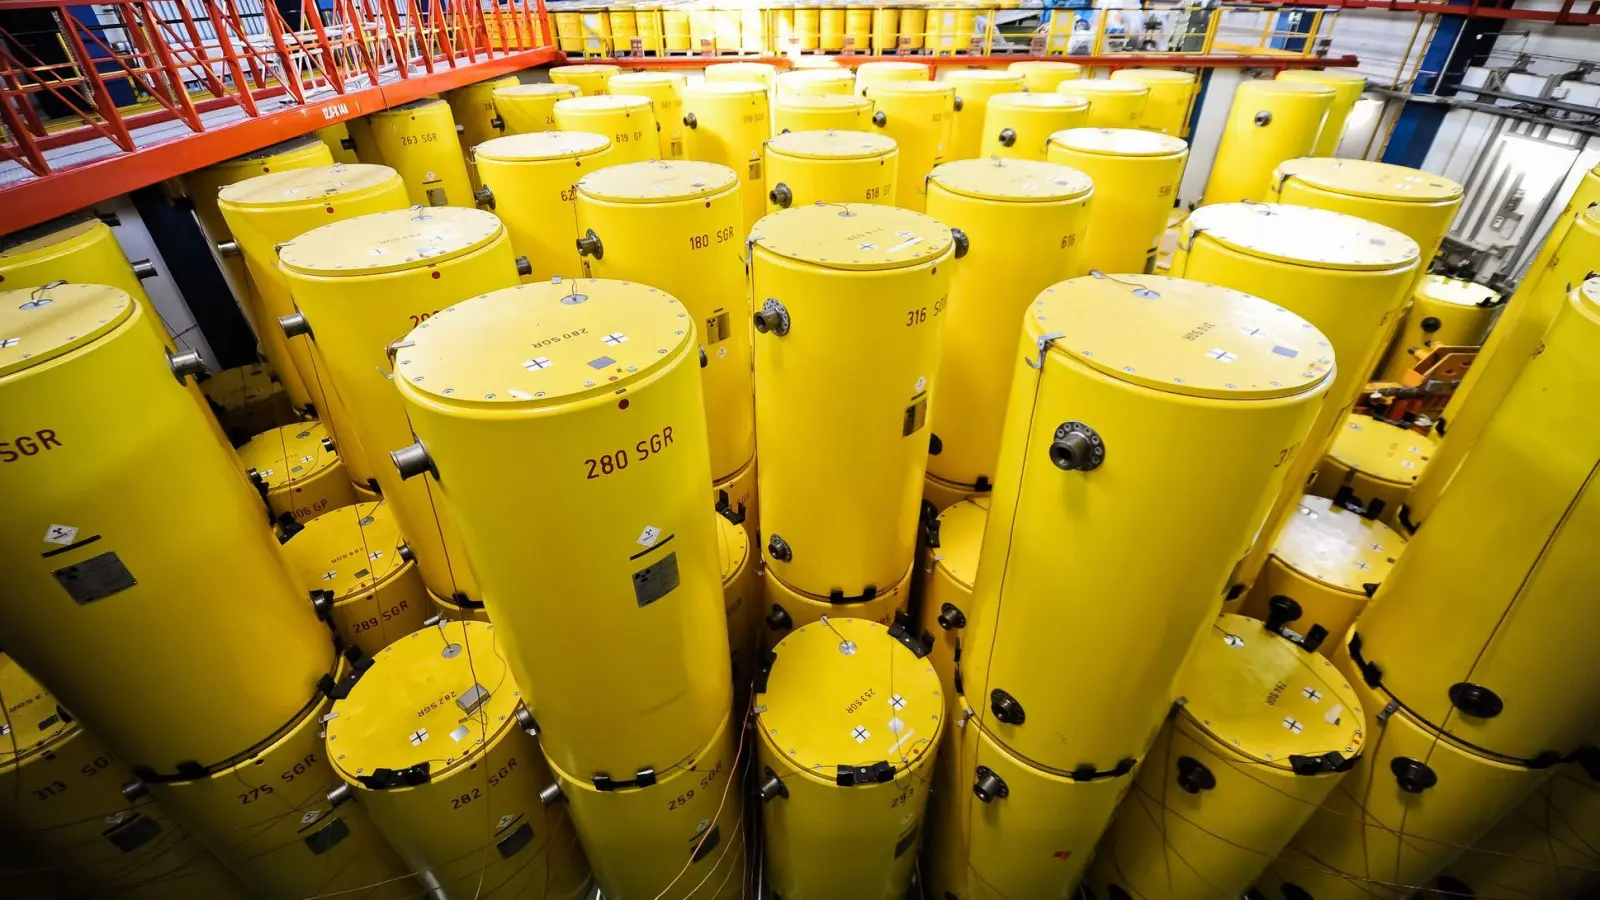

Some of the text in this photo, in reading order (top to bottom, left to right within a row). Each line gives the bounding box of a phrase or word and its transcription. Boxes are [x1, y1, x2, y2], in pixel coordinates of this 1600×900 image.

[401, 132, 438, 146] 263 SGR
[615, 131, 643, 143] 619 GP
[689, 225, 733, 250] 180 SGR
[906, 307, 927, 327] 316
[532, 328, 589, 348] 280 SGR
[0, 429, 62, 463] SGR
[584, 426, 674, 479] 280 SGR
[313, 498, 328, 512] GP
[353, 600, 409, 634] 289 SGR
[417, 690, 457, 718] 282 SGR
[845, 688, 876, 714] 253 SGR
[32, 780, 68, 802] 313
[238, 753, 317, 805] 275 SGR
[451, 757, 518, 810] 282 SGR
[668, 789, 694, 811] 259
